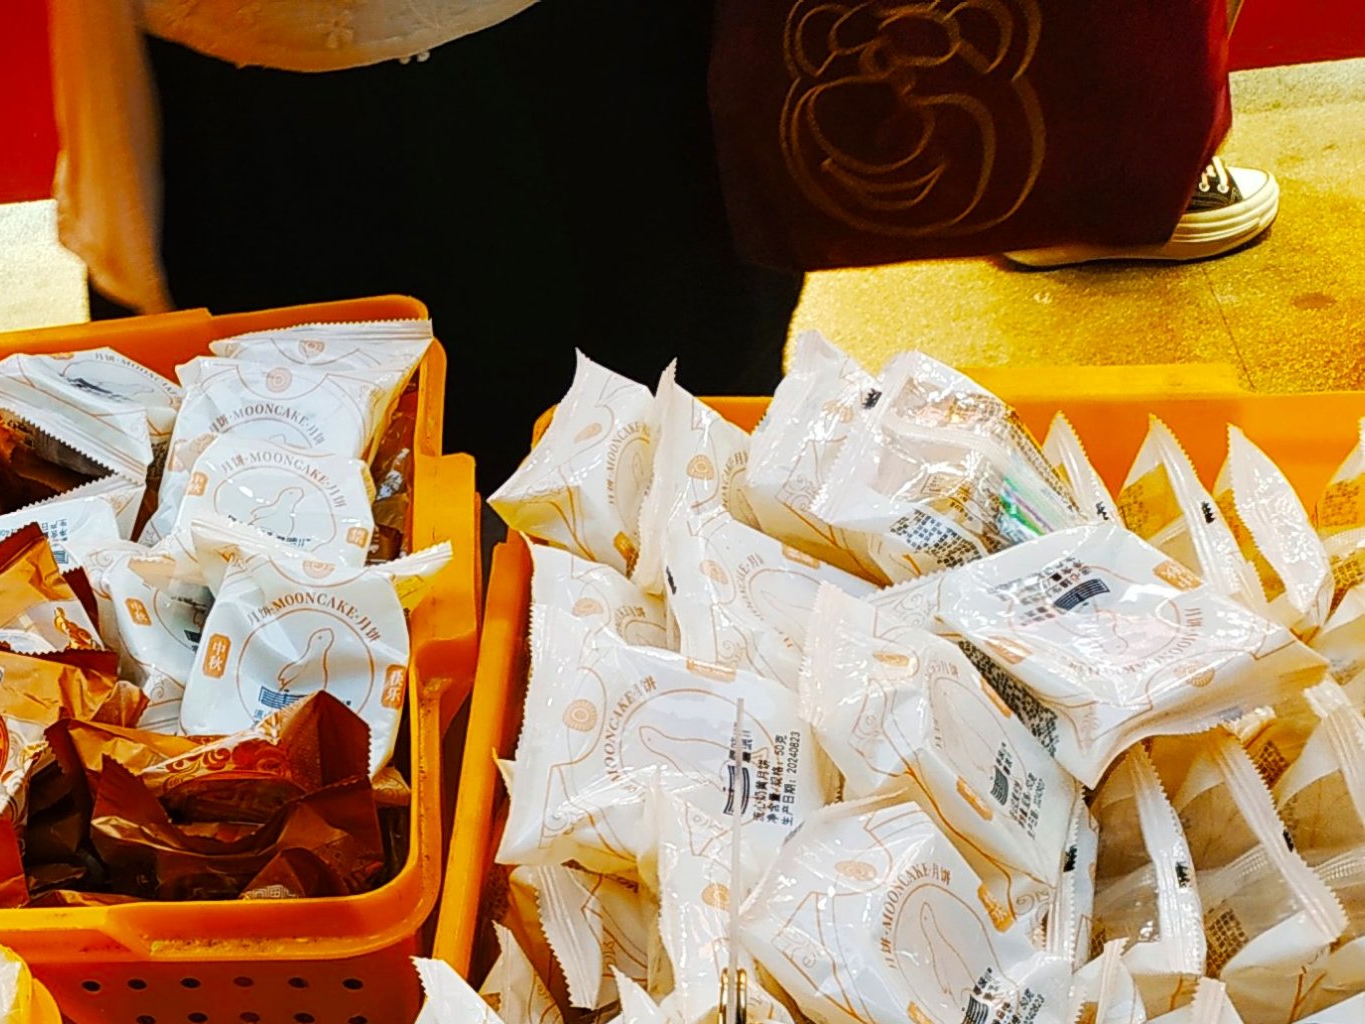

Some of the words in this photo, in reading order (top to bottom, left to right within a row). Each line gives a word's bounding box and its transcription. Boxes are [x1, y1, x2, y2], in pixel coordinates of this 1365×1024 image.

[247, 591, 381, 643] 月饼·MOONCAKE·月饼
[208, 640, 228, 672] 中秋
[386, 669, 405, 702] 快乐
